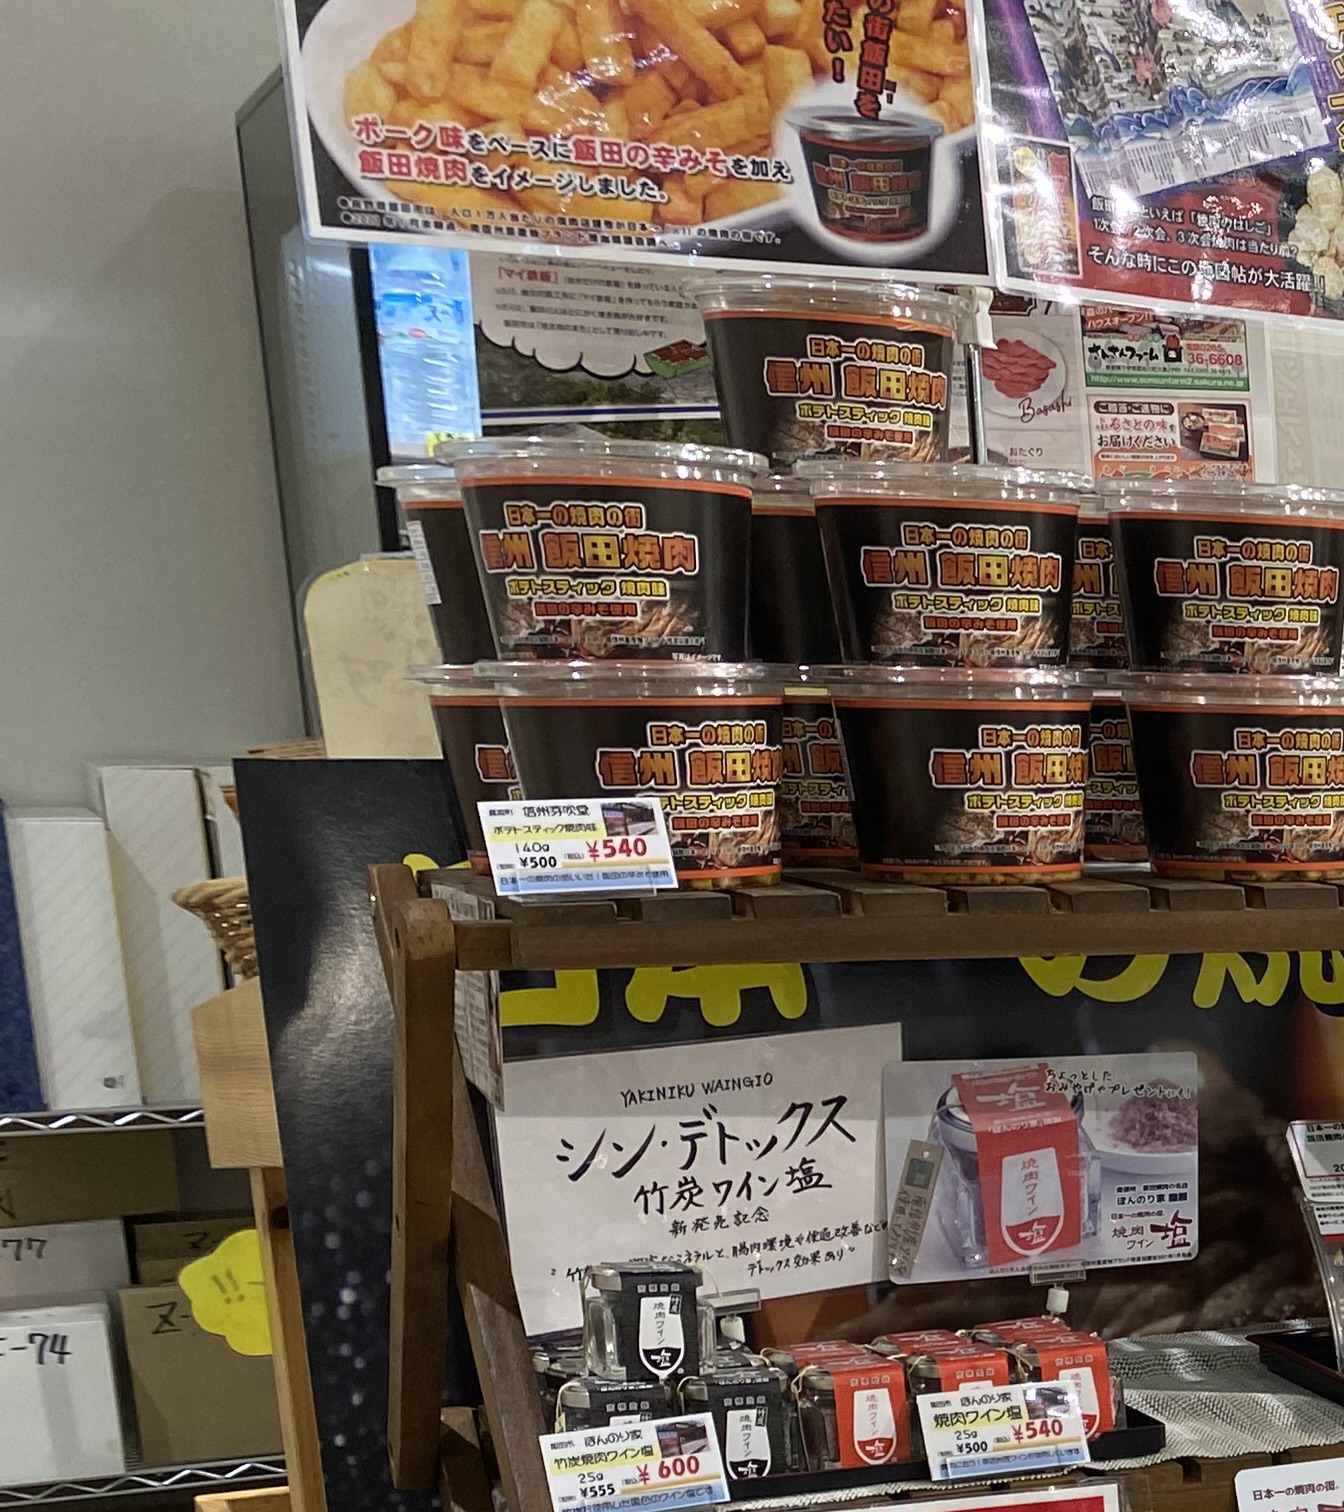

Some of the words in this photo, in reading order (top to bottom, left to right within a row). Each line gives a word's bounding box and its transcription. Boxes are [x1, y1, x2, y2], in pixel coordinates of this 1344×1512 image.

[353, 115, 794, 183] ポーク味をベースに飯田の辛みそを加え
[357, 147, 671, 203] 飯田焼肉をイメージしました。
[807, 336, 923, 367] 日本一の焼肉の街
[1186, 350, 1244, 367] 36-6608
[766, 358, 832, 401] 信州
[843, 362, 948, 407] 飯田焼肉
[799, 404, 897, 424] ポテトスティック
[503, 501, 645, 529] 日本一の焼肉の街
[901, 523, 1030, 551] 日本一の焼肉の街
[1194, 538, 1312, 564] 日本一の焼肉の街
[480, 531, 534, 573] 信州
[541, 530, 699, 574] 飯田焼肉
[861, 548, 928, 587] 信州
[938, 548, 1062, 590] 飯田焼肉
[1154, 560, 1217, 598] 信州
[1227, 561, 1340, 603] 飯田焼肉
[506, 579, 615, 597] ポテトスティック
[648, 723, 767, 748] 日本一の焼肉の街
[979, 725, 1082, 750] 日本一の焼肉の街
[1234, 728, 1344, 752] 日本一の焼肉の街
[597, 749, 678, 788] 信州
[929, 750, 1005, 787] 信州
[1190, 750, 1259, 788] 信州
[519, 856, 558, 869] ¥500
[586, 838, 648, 862] ¥540
[1045, 1068, 1113, 1083] ちょっとした
[620, 1082, 696, 1108] YAKINIKU
[556, 1095, 857, 1184] シン・デトックス
[634, 1157, 833, 1215] 竹炭ワイン塩
[933, 1406, 1023, 1429] 焼肉ワイン塩
[1010, 1418, 1064, 1443] ¥540
[553, 1443, 655, 1472] 竹炭焼肉ワイン塩
[956, 1441, 988, 1454] ¥500
[637, 1455, 700, 1486] ¥600
[579, 1483, 616, 1498] ¥555
